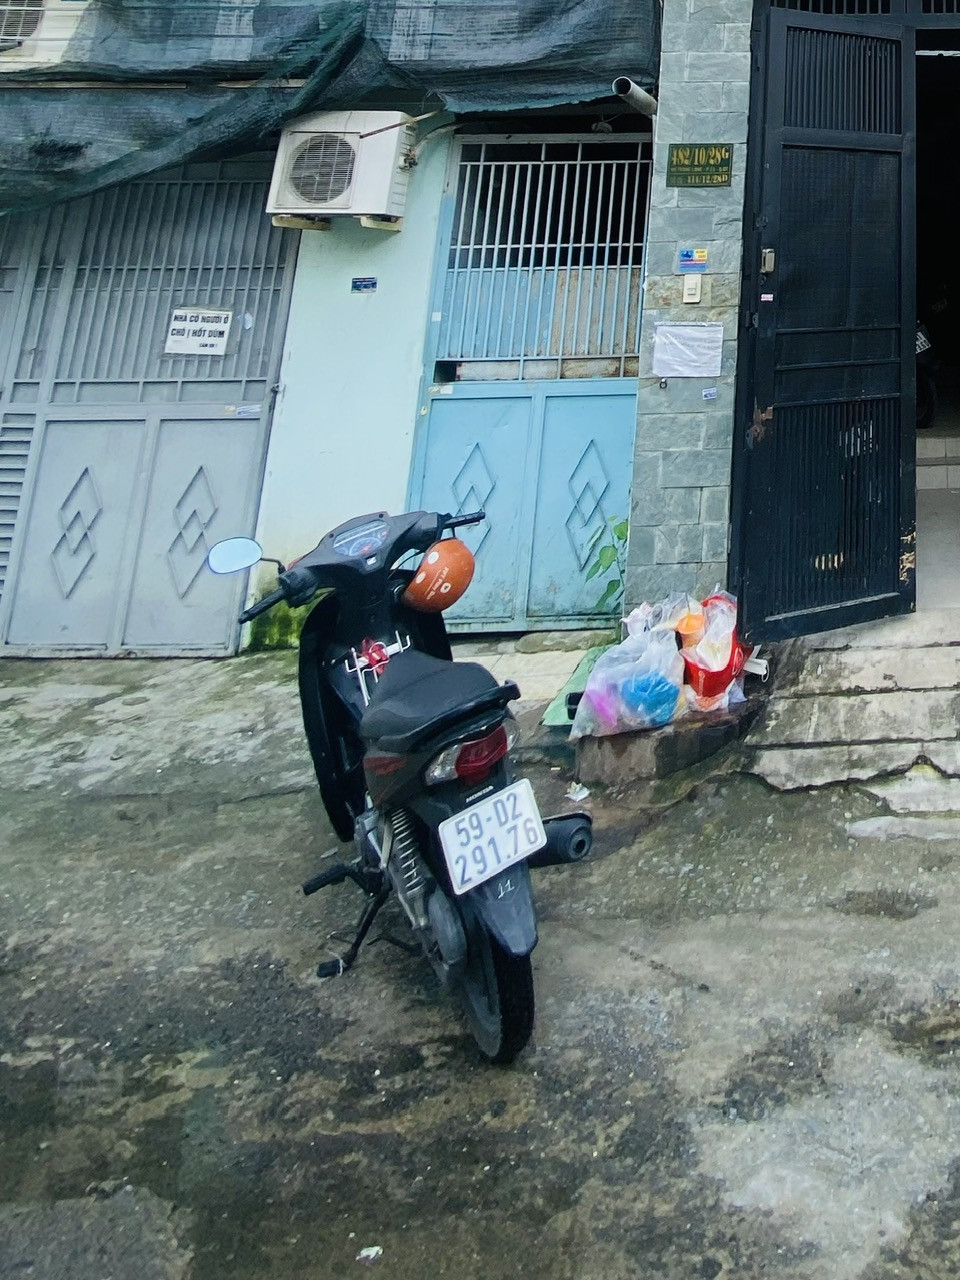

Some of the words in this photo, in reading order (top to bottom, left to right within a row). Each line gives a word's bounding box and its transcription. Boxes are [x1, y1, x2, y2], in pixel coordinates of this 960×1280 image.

[672, 146, 729, 165] 482/10/28G
[191, 326, 207, 338] HỐT
[466, 785, 494, 803] HONDA
[454, 792, 523, 847] 59-D2
[454, 817, 539, 886] 291.76
